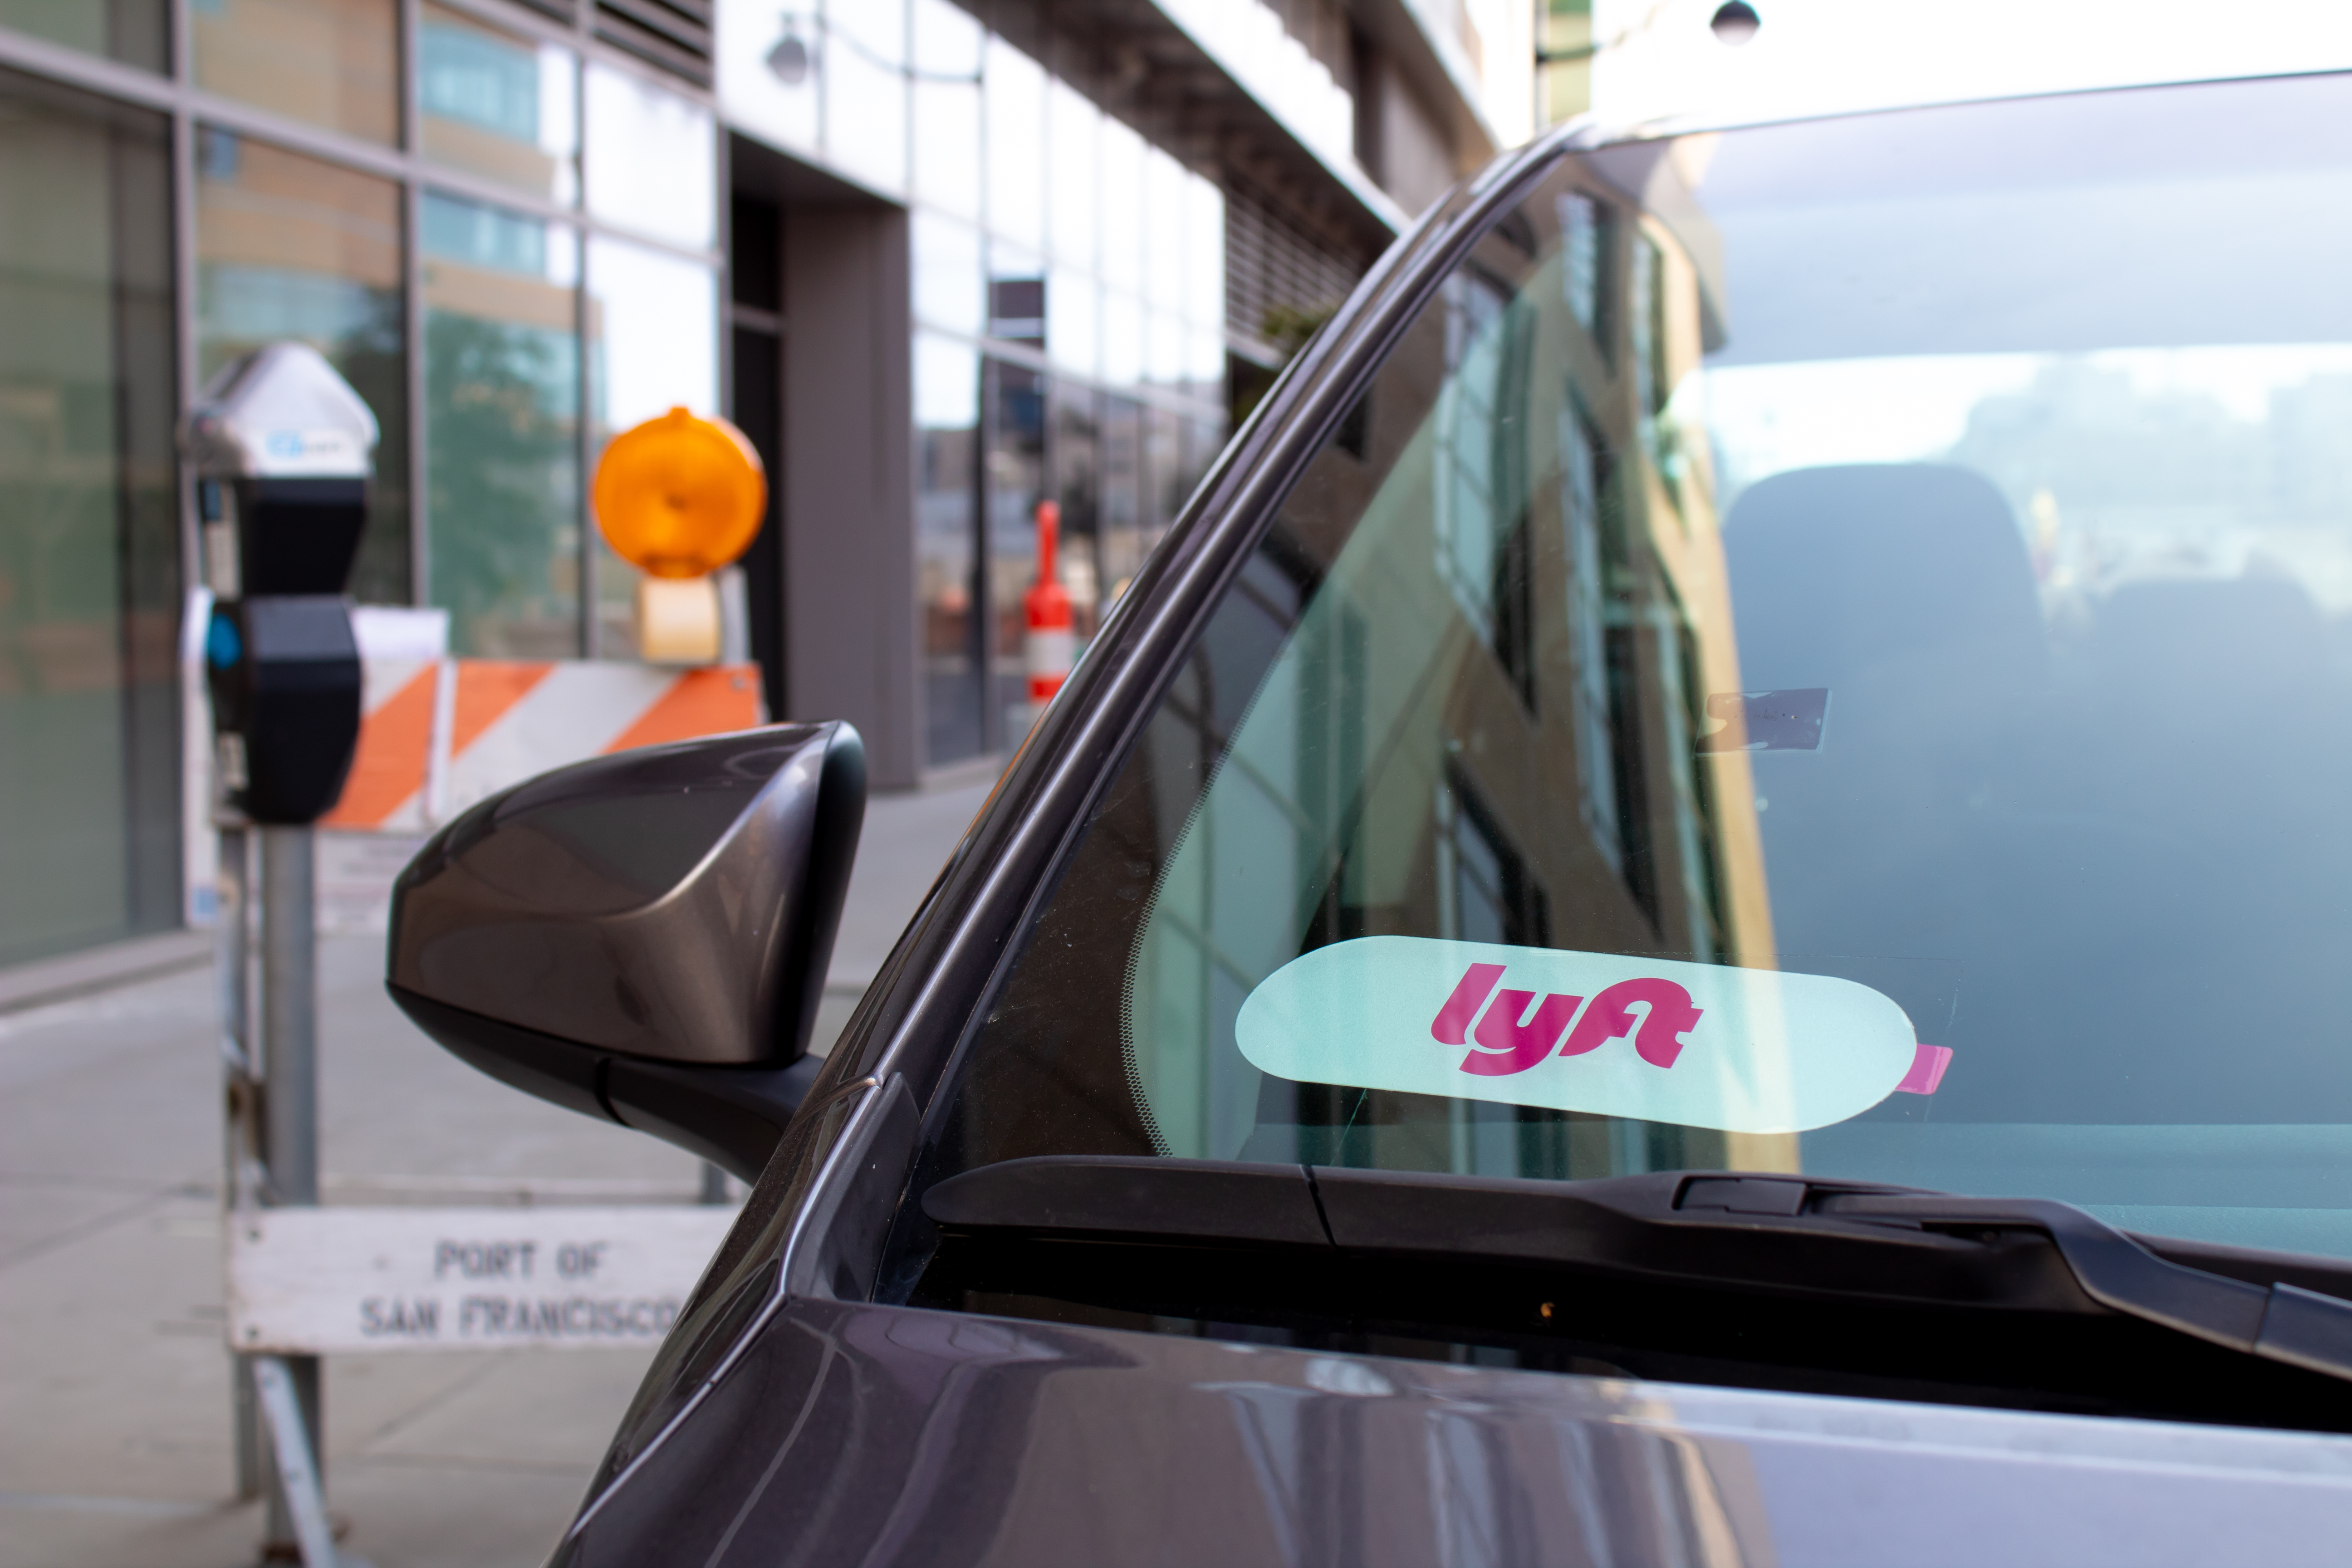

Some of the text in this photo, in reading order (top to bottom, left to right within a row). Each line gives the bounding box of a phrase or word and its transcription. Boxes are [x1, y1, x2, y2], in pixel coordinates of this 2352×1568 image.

[1431, 963, 1704, 1077] lyft
[434, 1240, 609, 1280] PORT OF
[360, 1295, 681, 1337] SAN FRANCISCO
